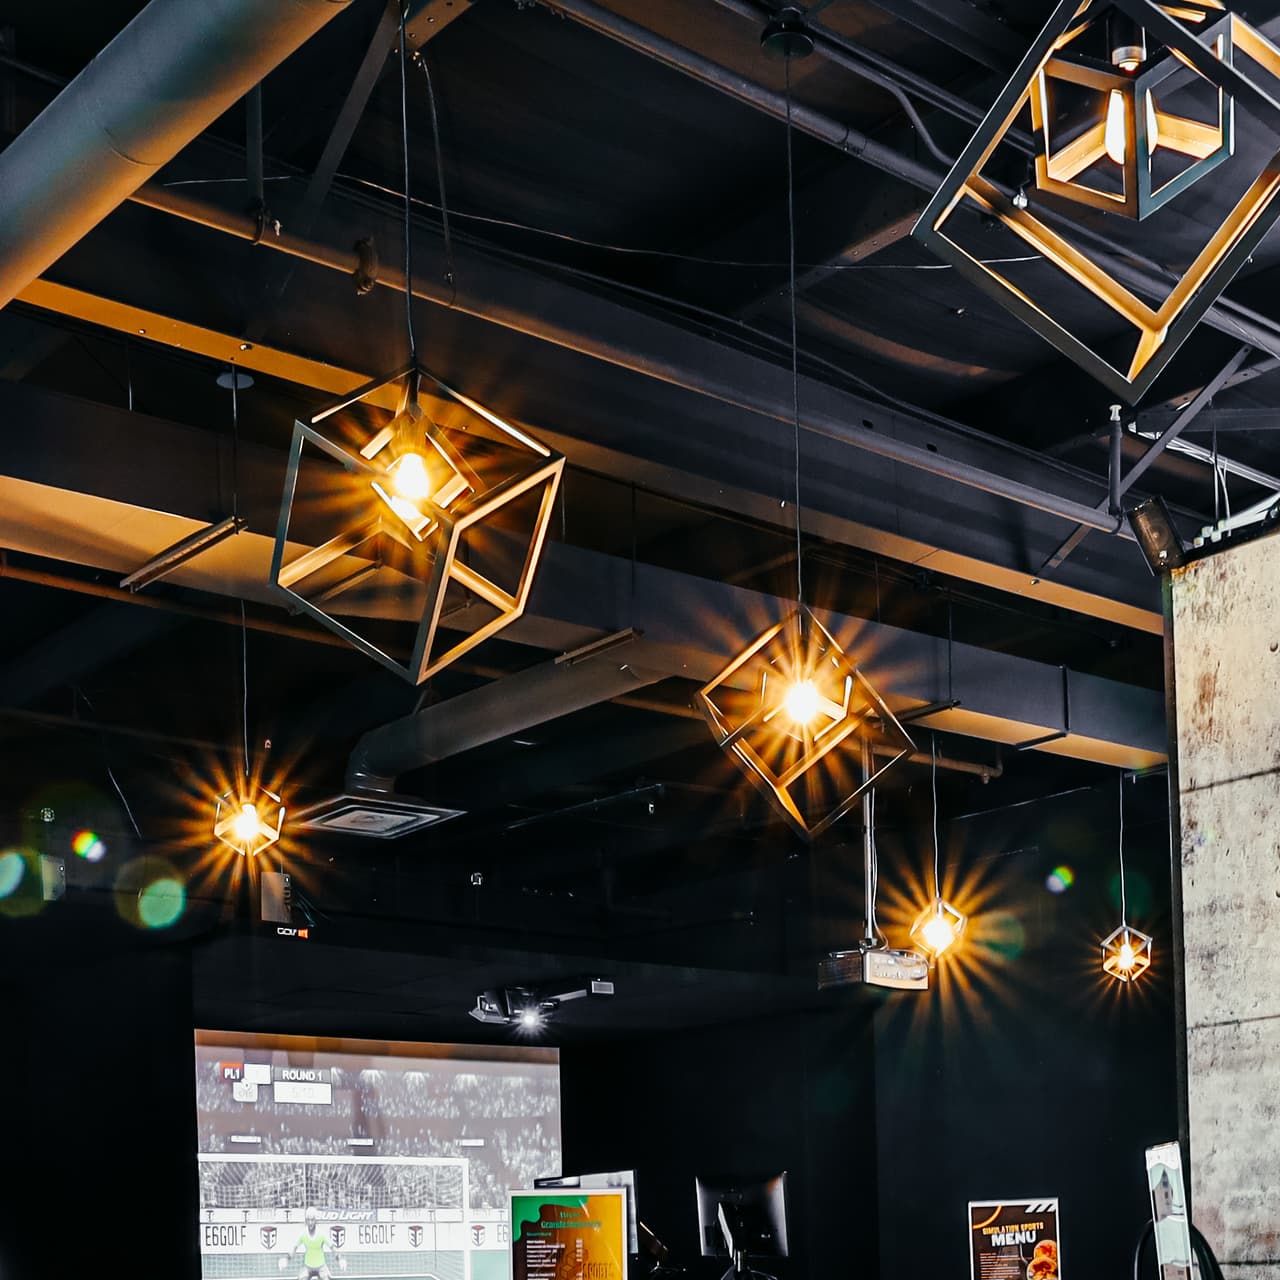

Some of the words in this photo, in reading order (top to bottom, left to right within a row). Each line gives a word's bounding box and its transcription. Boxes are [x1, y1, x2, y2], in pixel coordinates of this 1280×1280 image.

[282, 1070, 315, 1081] ROUND
[205, 1225, 247, 1246] E6GOLF
[359, 1224, 396, 1245] E6GOLF
[983, 1225, 1019, 1235] SIMULATION
[1021, 1222, 1044, 1231] SPORTS
[992, 1231, 1036, 1247] MENU
